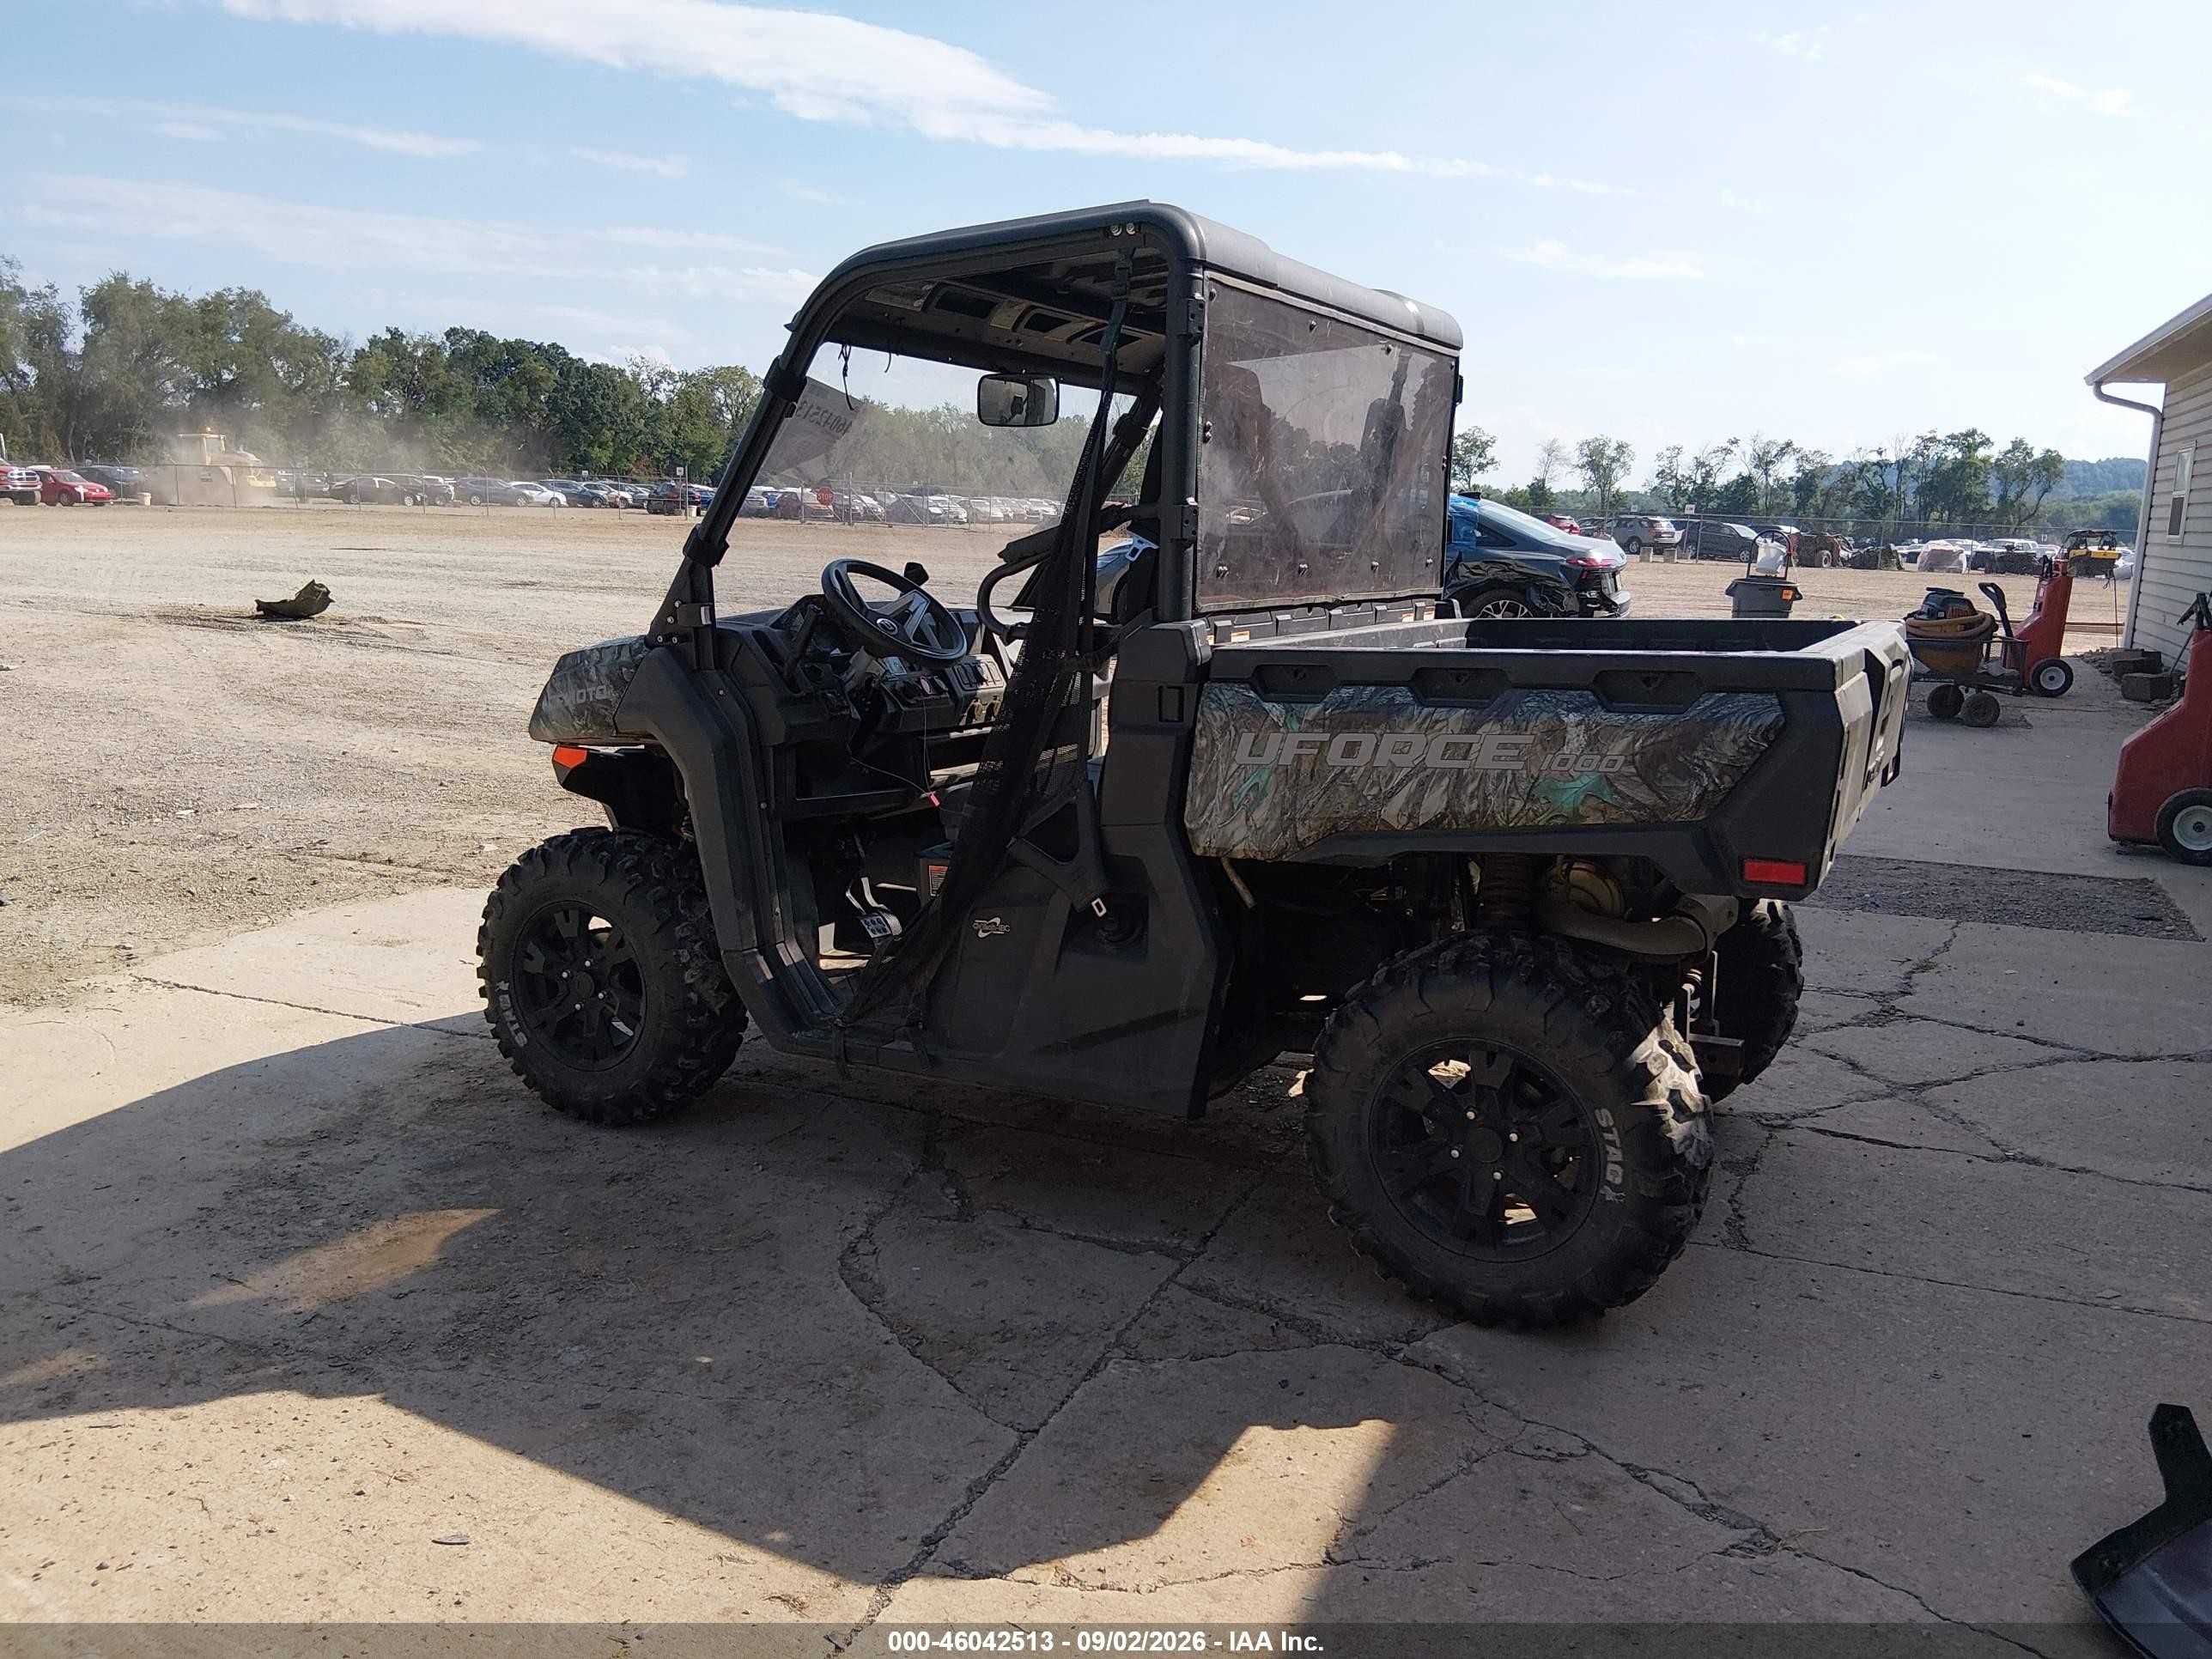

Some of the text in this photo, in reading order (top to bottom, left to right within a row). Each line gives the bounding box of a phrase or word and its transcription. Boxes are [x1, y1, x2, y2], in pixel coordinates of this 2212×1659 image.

[1235, 732, 1626, 772] UFORCE 1000
[1595, 1108, 1623, 1185] STAG
